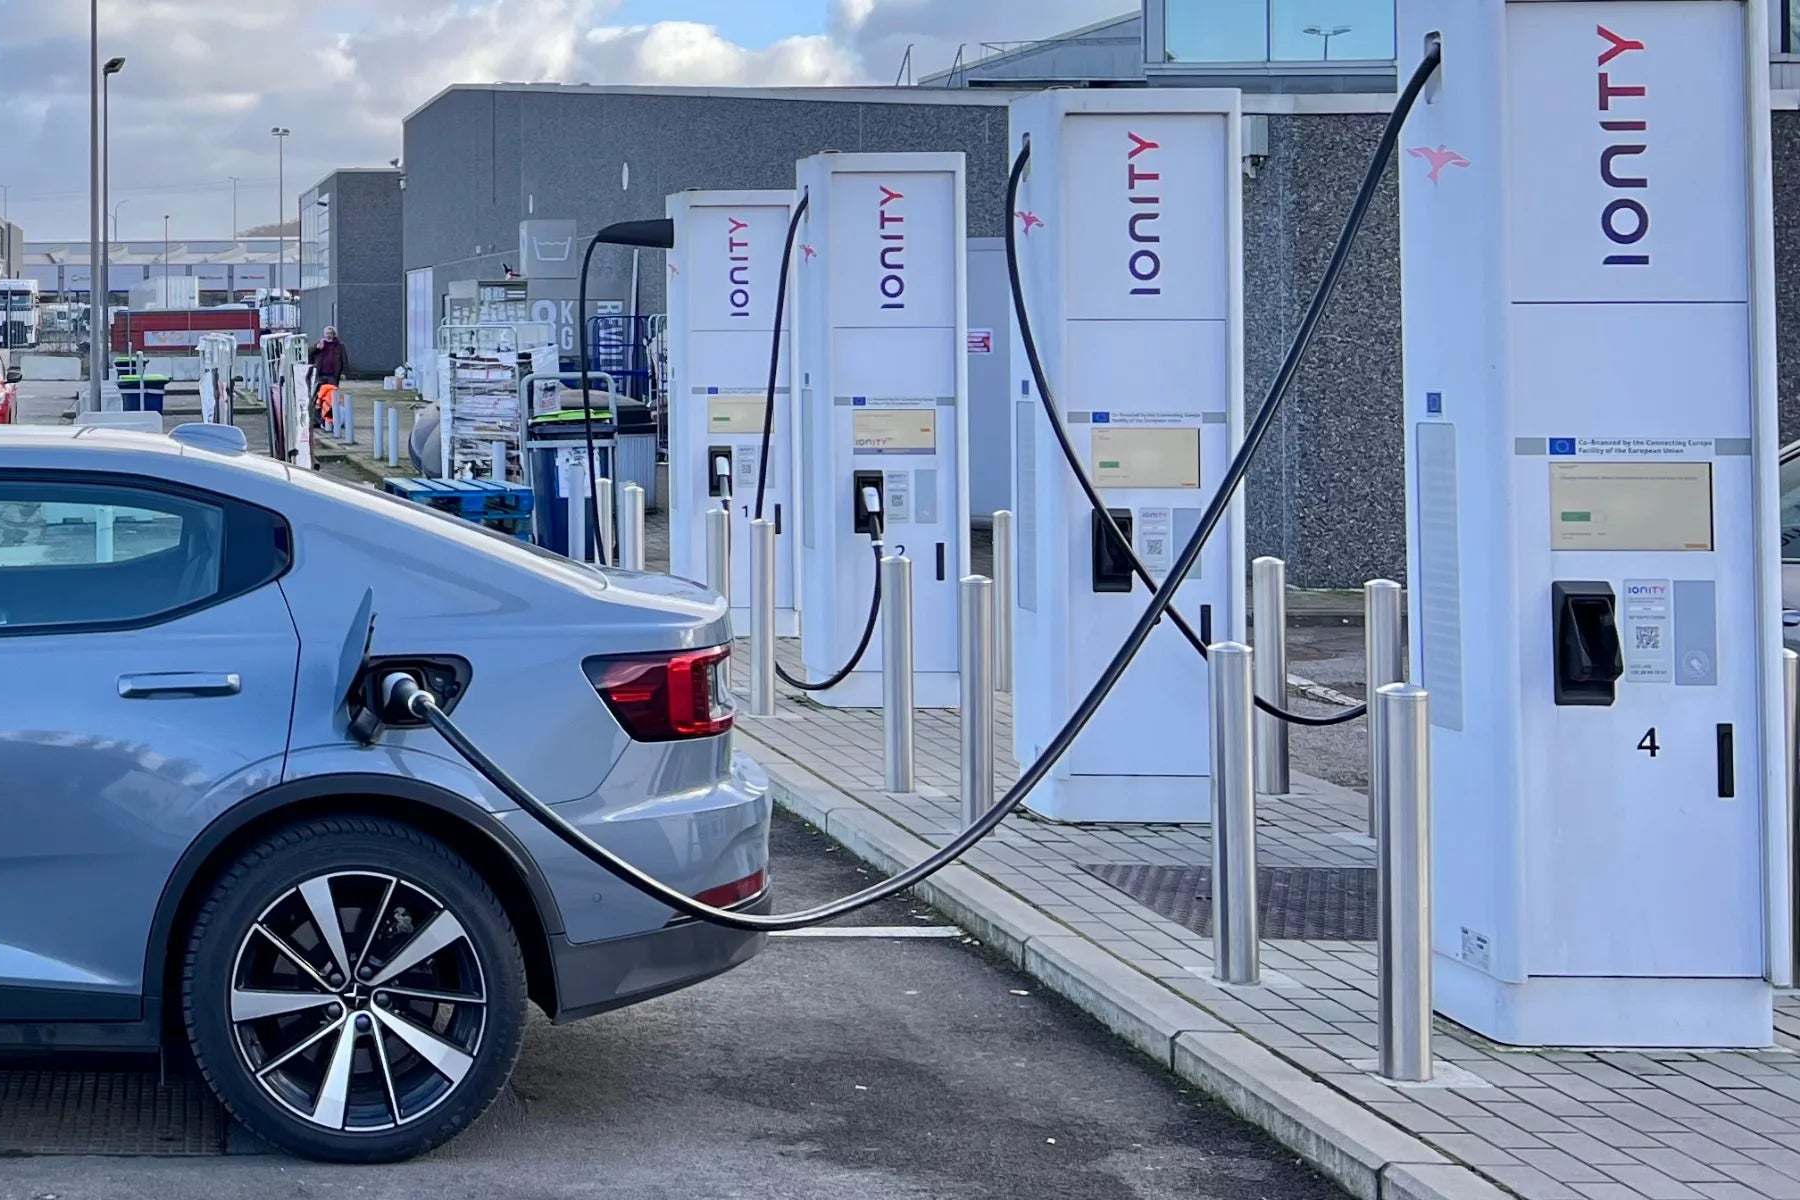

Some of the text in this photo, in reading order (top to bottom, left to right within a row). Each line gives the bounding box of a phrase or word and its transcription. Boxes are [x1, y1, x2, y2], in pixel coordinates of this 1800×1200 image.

[1596, 24, 1650, 265] IONITY
[879, 184, 905, 309] IONITY
[1127, 131, 1161, 295] IONITY
[728, 216, 750, 317] IONITY
[742, 504, 749, 518] 1
[1628, 586, 1665, 594] IONITY
[1637, 727, 1661, 757] 4
